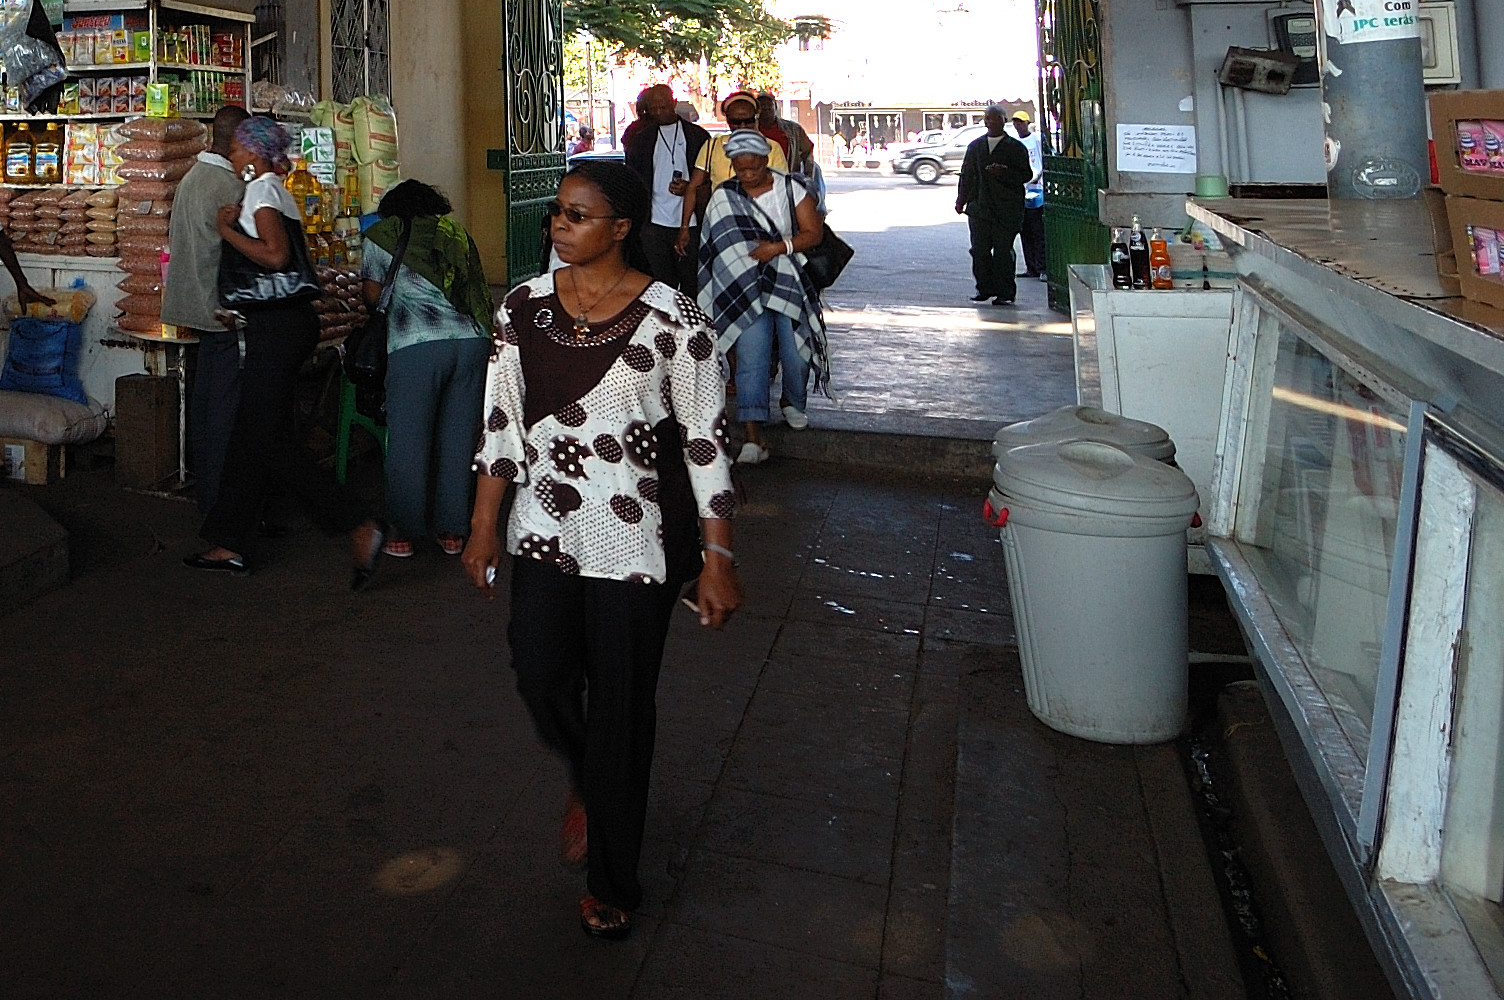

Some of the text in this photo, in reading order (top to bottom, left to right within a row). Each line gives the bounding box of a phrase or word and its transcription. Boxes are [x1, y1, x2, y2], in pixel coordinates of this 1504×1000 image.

[1384, 0, 1411, 11] Com
[1353, 13, 1414, 32] JPC terás
